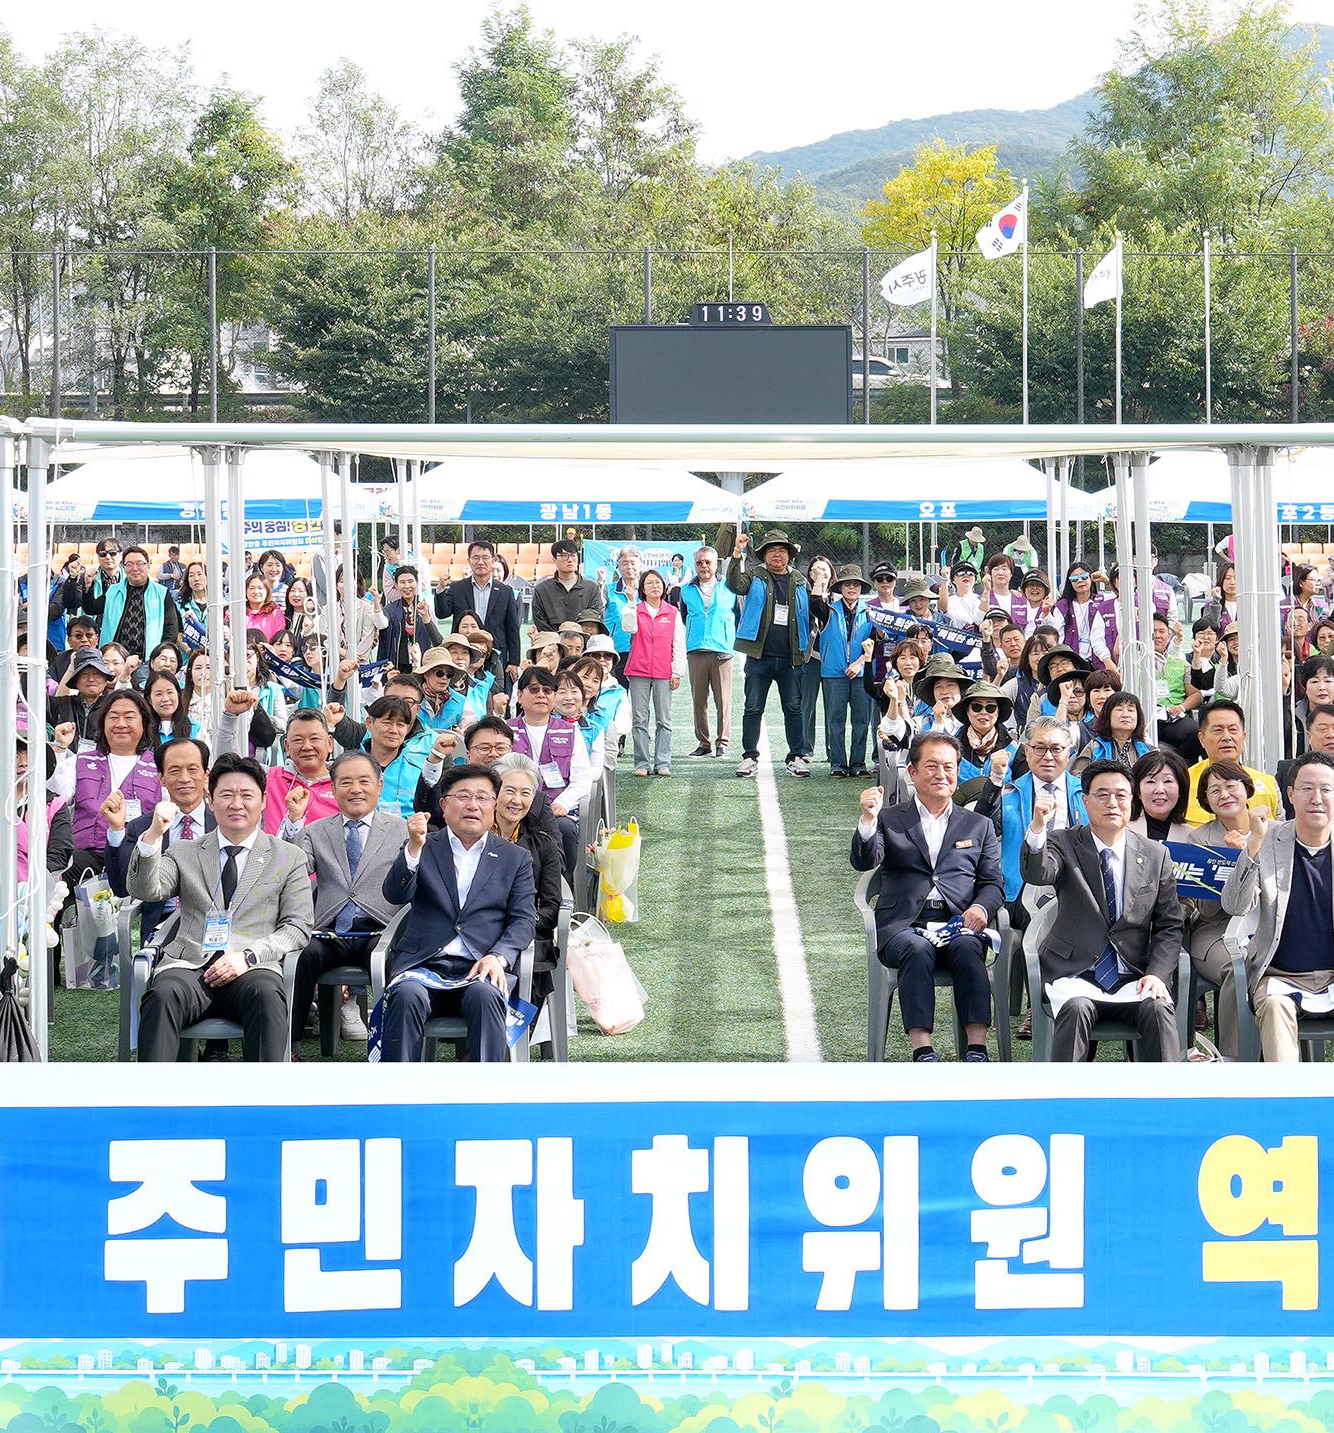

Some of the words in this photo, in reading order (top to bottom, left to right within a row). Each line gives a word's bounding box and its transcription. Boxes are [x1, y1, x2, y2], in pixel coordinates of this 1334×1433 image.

[701, 305, 764, 322] 11:39
[539, 502, 612, 520] 광남1동
[919, 501, 957, 518] 오포
[104, 1133, 1085, 1314] 주민자치위원
